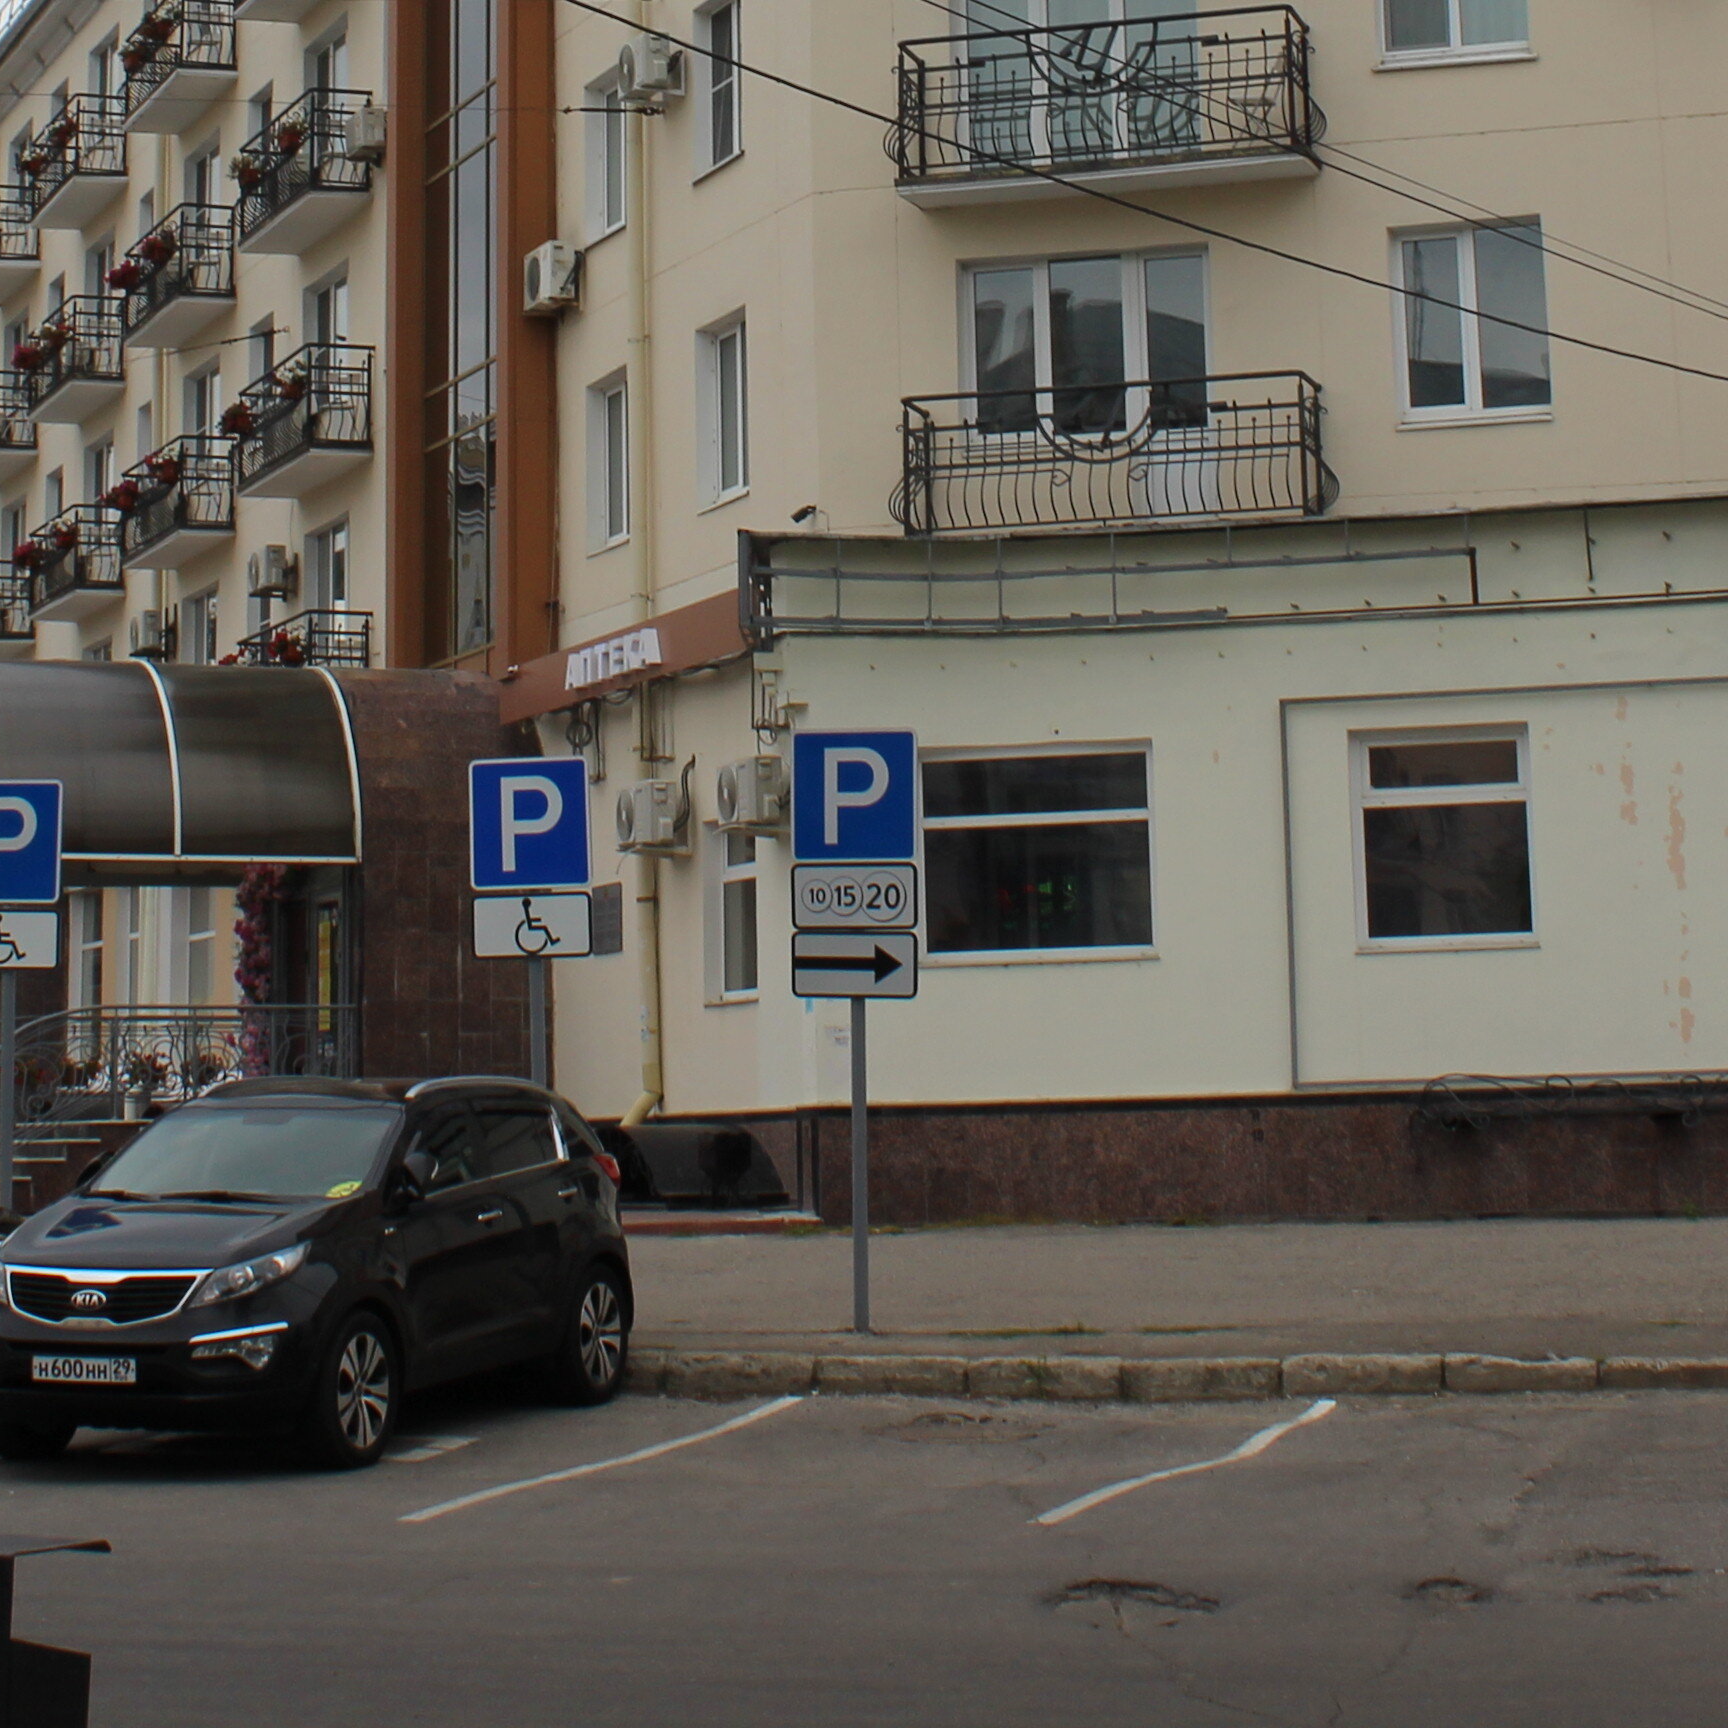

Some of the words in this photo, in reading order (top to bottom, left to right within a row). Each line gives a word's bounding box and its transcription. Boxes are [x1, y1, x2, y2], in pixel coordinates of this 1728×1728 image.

[565, 627, 662, 690] АПТЕКА
[825, 747, 889, 844] P
[500, 775, 563, 872] P
[809, 888, 826, 904] 10
[834, 885, 856, 907] 15
[866, 883, 901, 909] 20
[75, 1294, 100, 1306] KIA
[113, 1359, 131, 1375] 29
